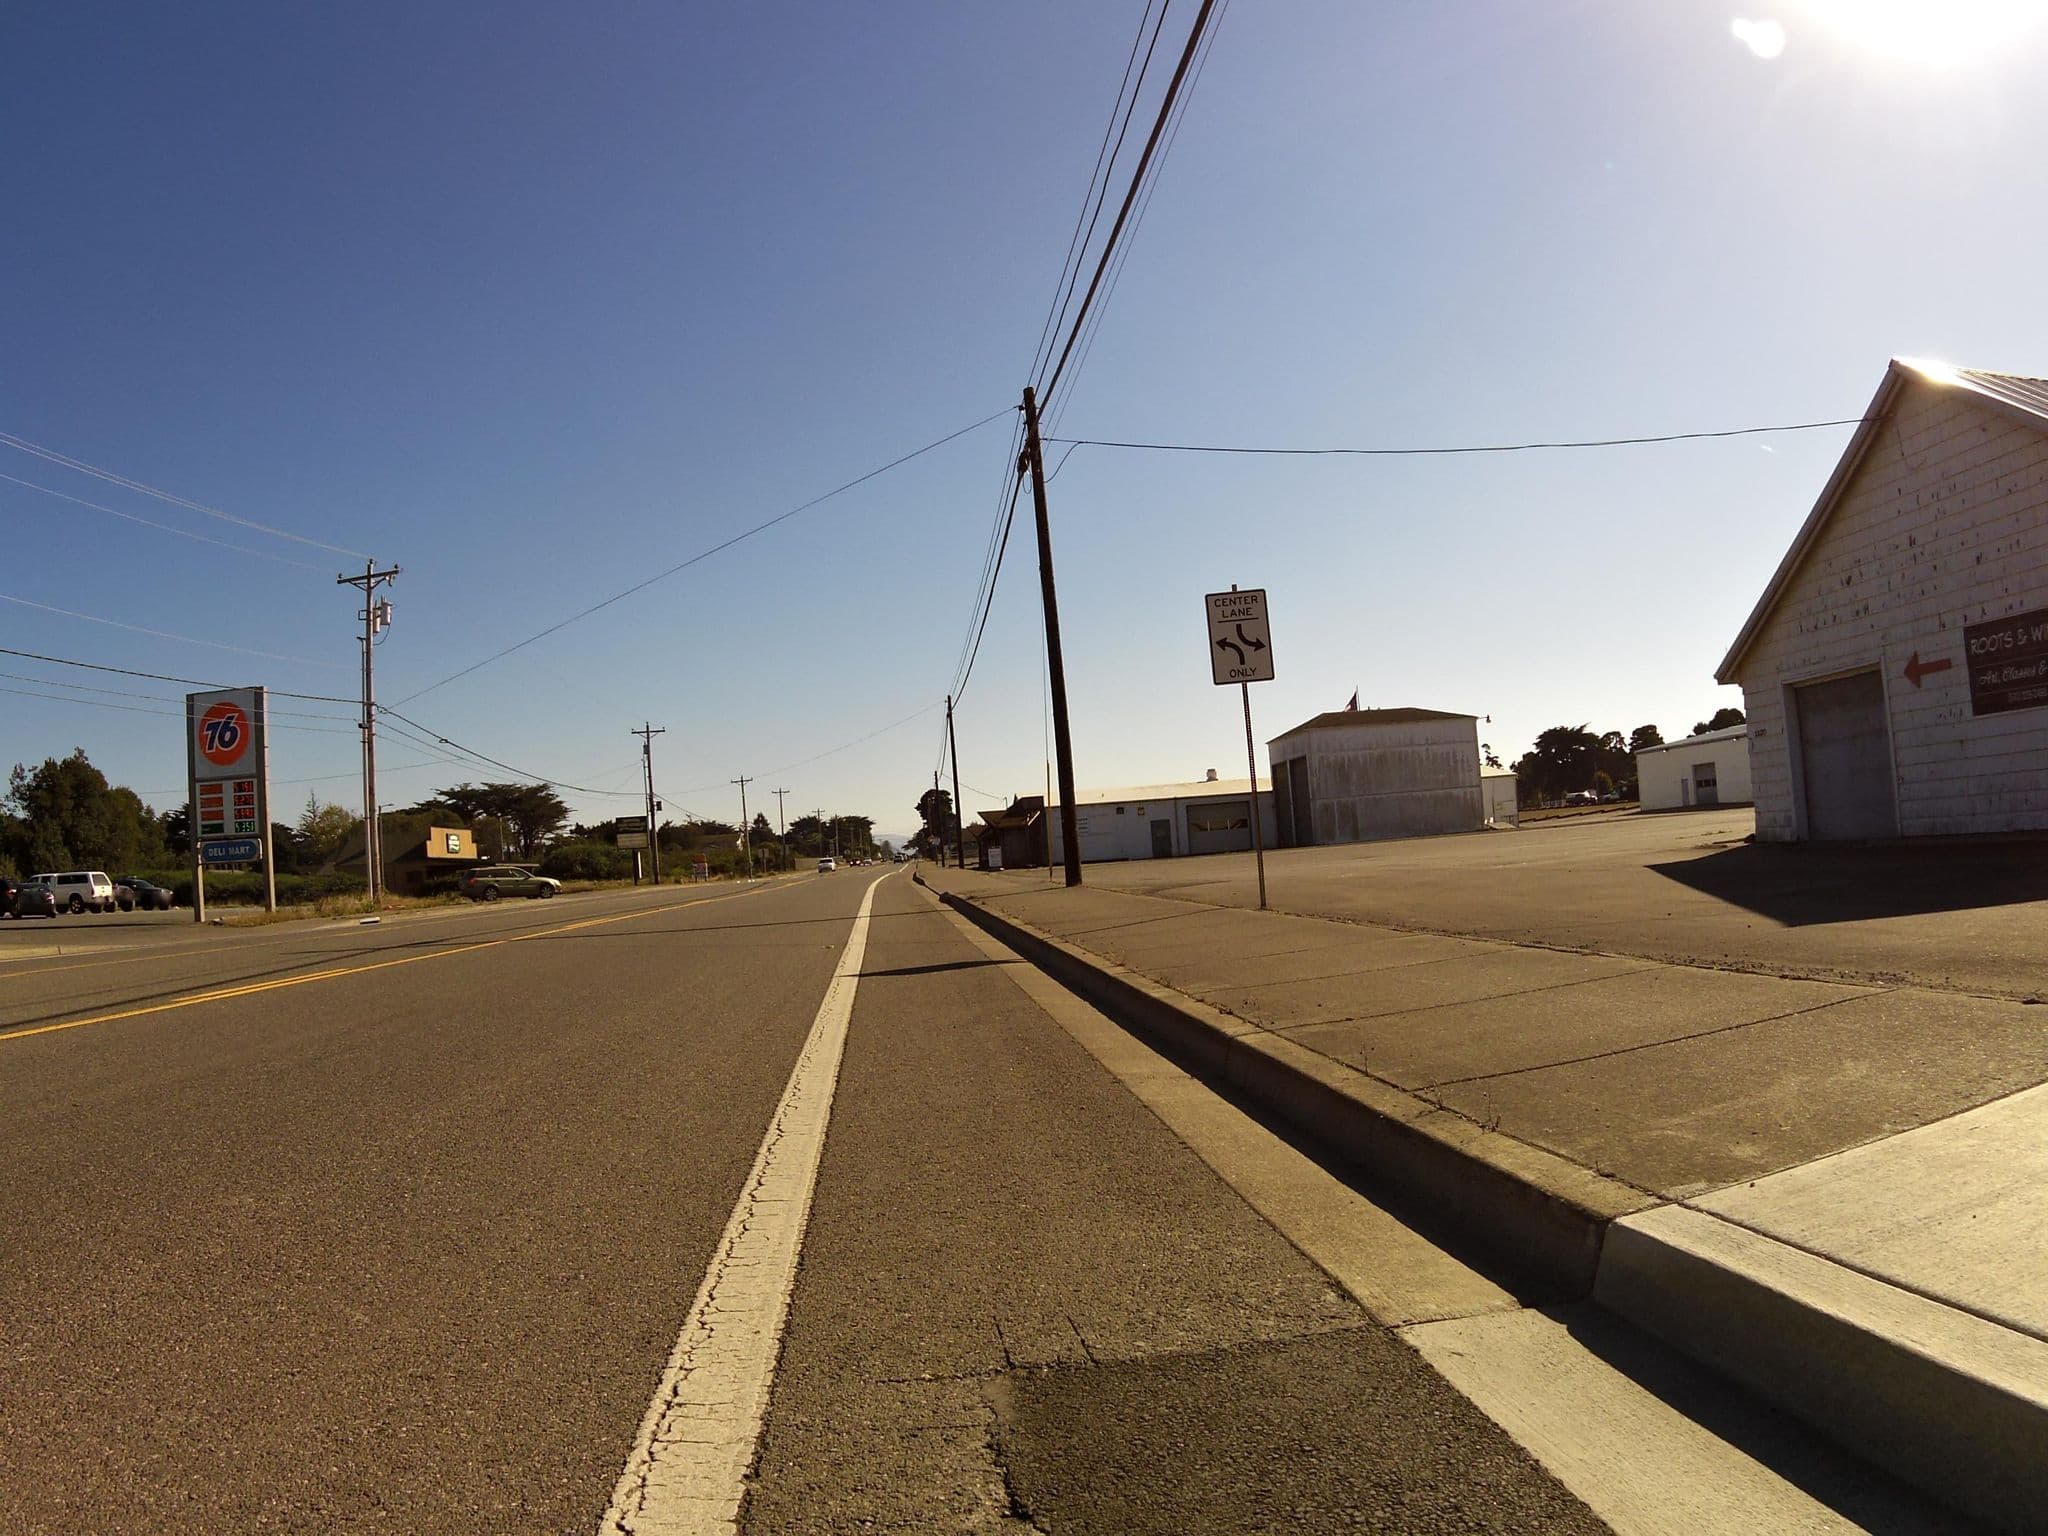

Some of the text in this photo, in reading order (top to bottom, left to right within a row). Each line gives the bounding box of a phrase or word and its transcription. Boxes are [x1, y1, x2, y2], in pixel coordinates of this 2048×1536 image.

[1214, 595, 1258, 607] CENTER
[1221, 607, 1253, 618] LANE
[1970, 631, 2013, 655] ROOTS
[2016, 628, 2028, 646] &
[1229, 667, 1257, 678] ONLY
[203, 713, 240, 753] 76
[208, 846, 250, 857] DELI MART
